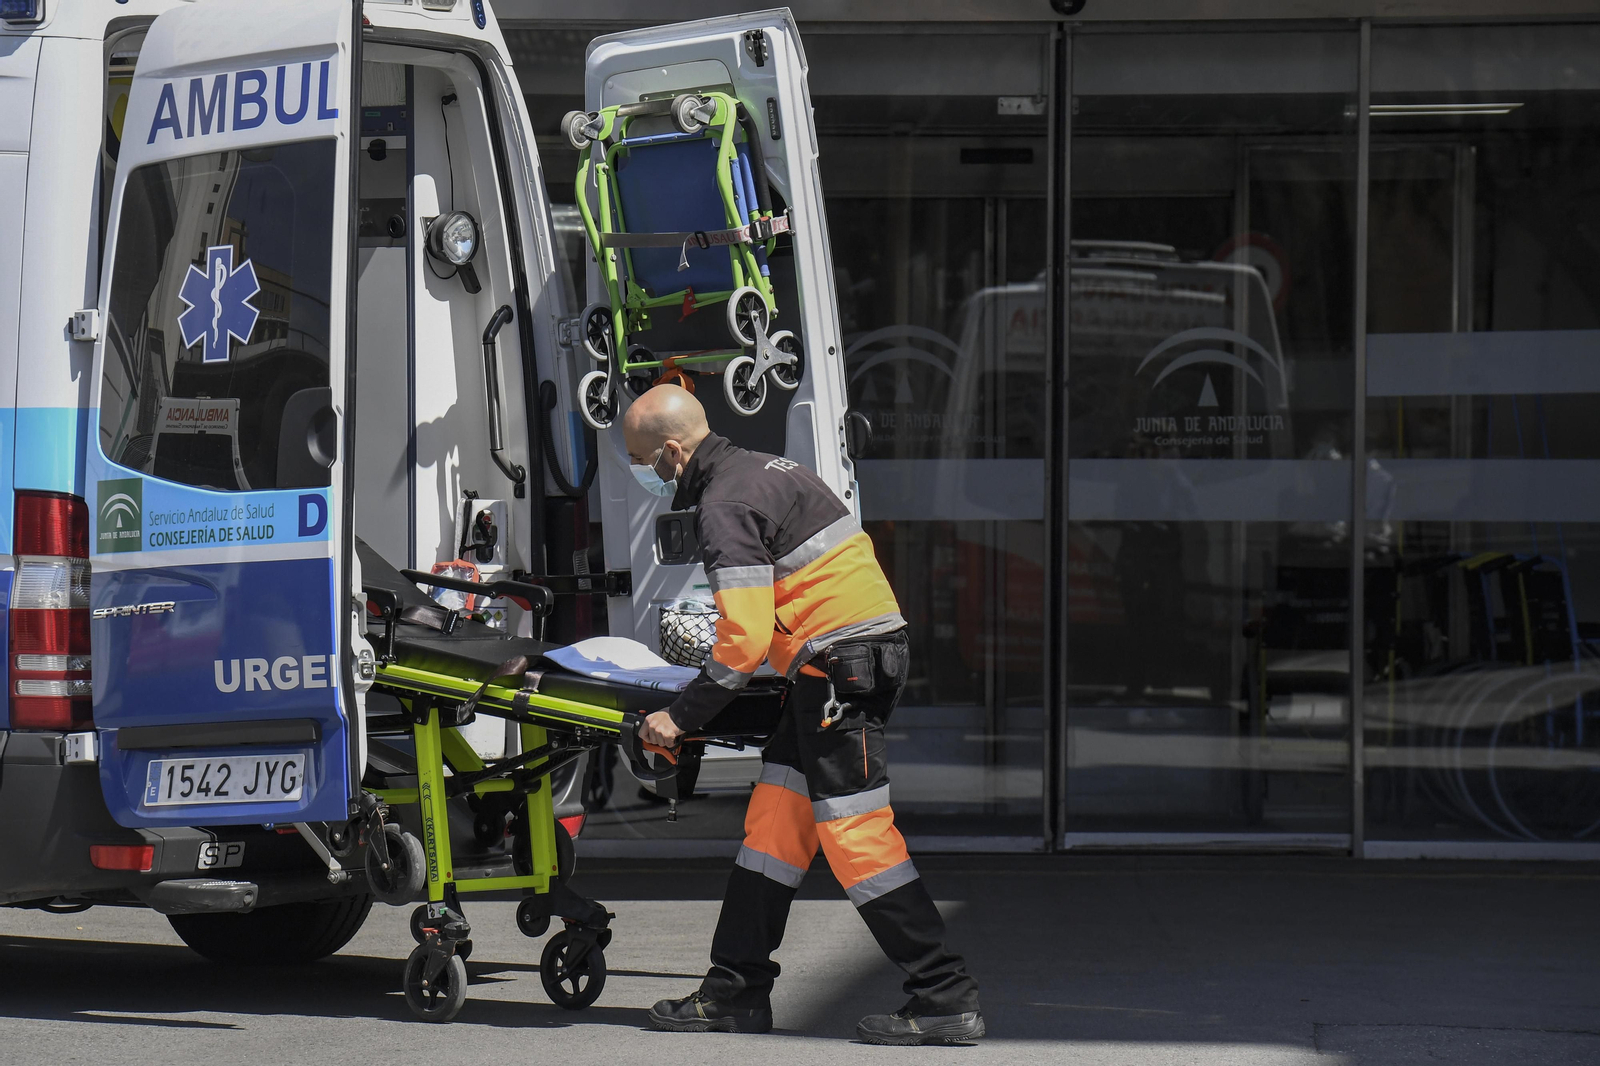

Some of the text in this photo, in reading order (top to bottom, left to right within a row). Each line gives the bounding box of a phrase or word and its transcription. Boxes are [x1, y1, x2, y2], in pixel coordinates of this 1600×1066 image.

[146, 60, 339, 145] AMBUL
[1133, 414, 1284, 433] JUNTA DE ANDALUCIA
[1215, 435, 1230, 445] de
[763, 457, 799, 473] TES
[149, 503, 275, 527] Servicio Andaluz de Salud
[298, 493, 328, 538] D
[149, 524, 275, 547] CONSEJERÍA DE SALUD
[92, 601, 176, 620] SPRINTER
[166, 760, 297, 799] 1542 JYG
[426, 823, 438, 881] KARTSANA
